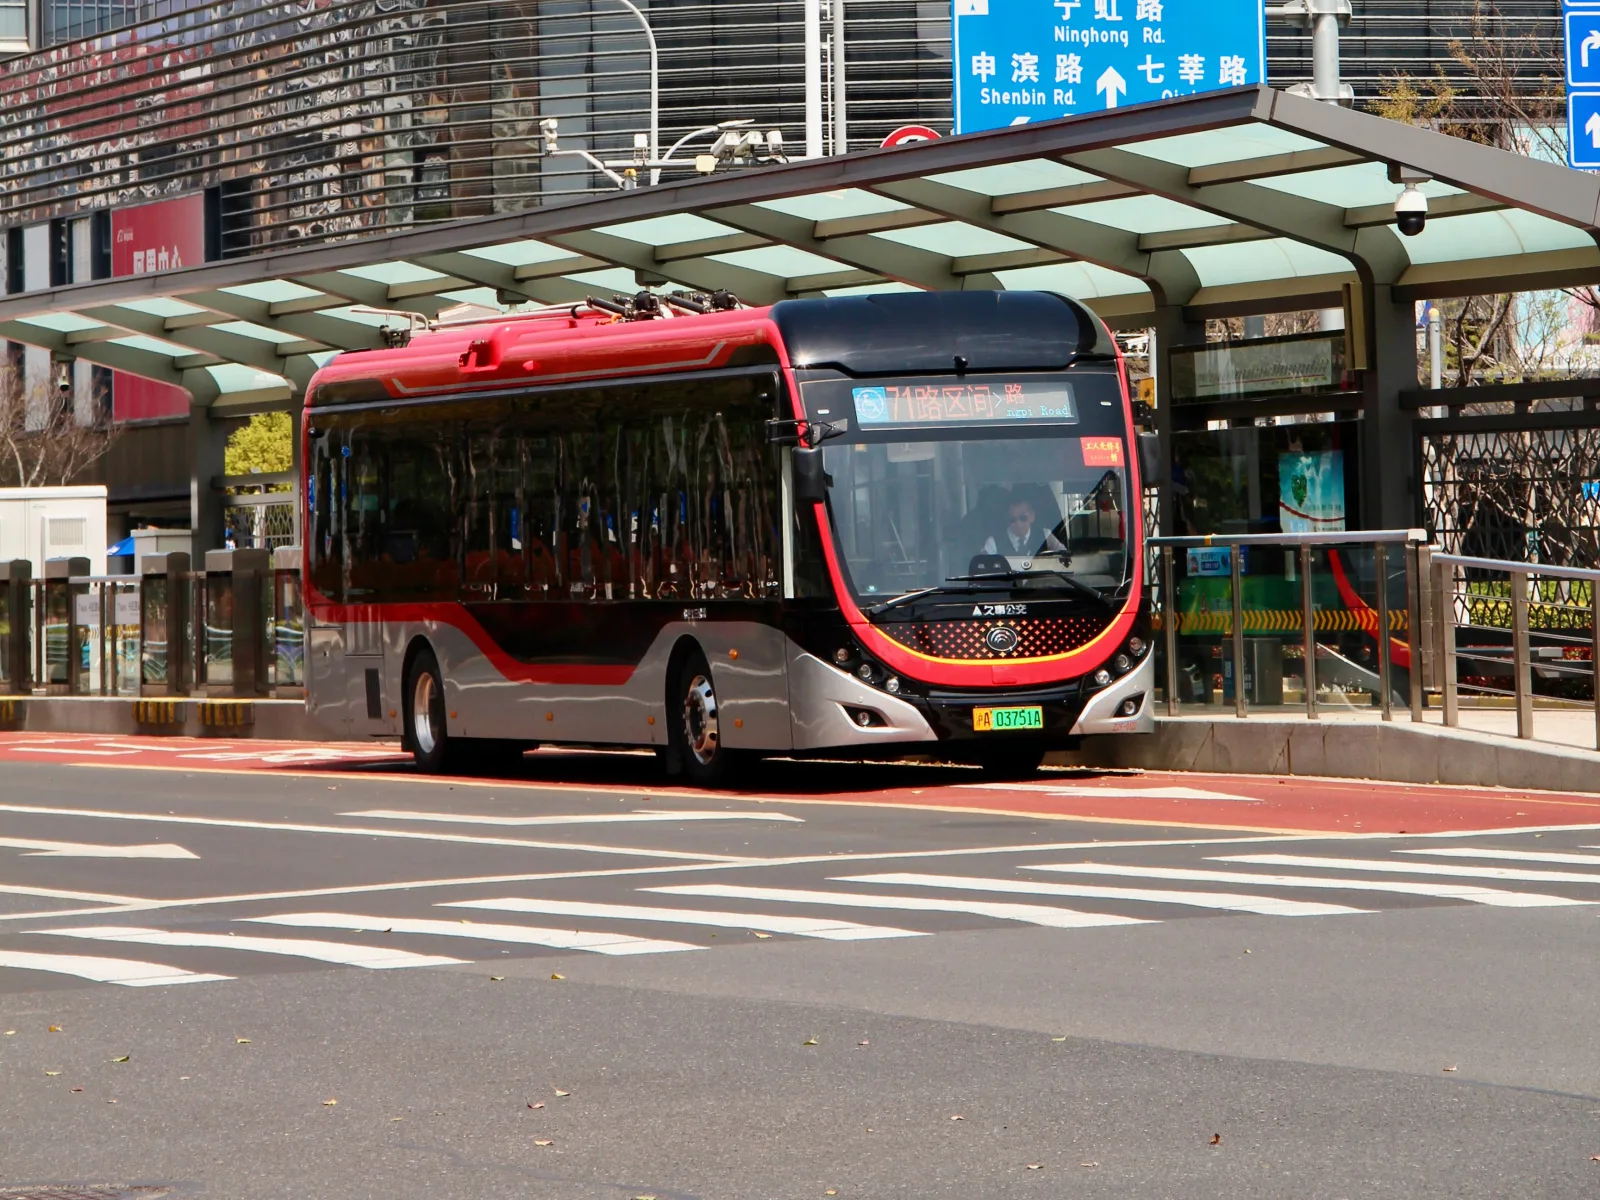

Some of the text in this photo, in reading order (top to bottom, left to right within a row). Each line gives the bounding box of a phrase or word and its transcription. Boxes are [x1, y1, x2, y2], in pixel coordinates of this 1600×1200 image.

[1053, 26, 1166, 48] Ninghong Rd.
[971, 51, 1084, 84] 申滨路
[1137, 54, 1248, 86] 七莘路
[979, 87, 1077, 105] Shenbin Rd.
[886, 384, 993, 421] 71路区间
[1004, 383, 1025, 405] 路
[1040, 404, 1070, 418] Road
